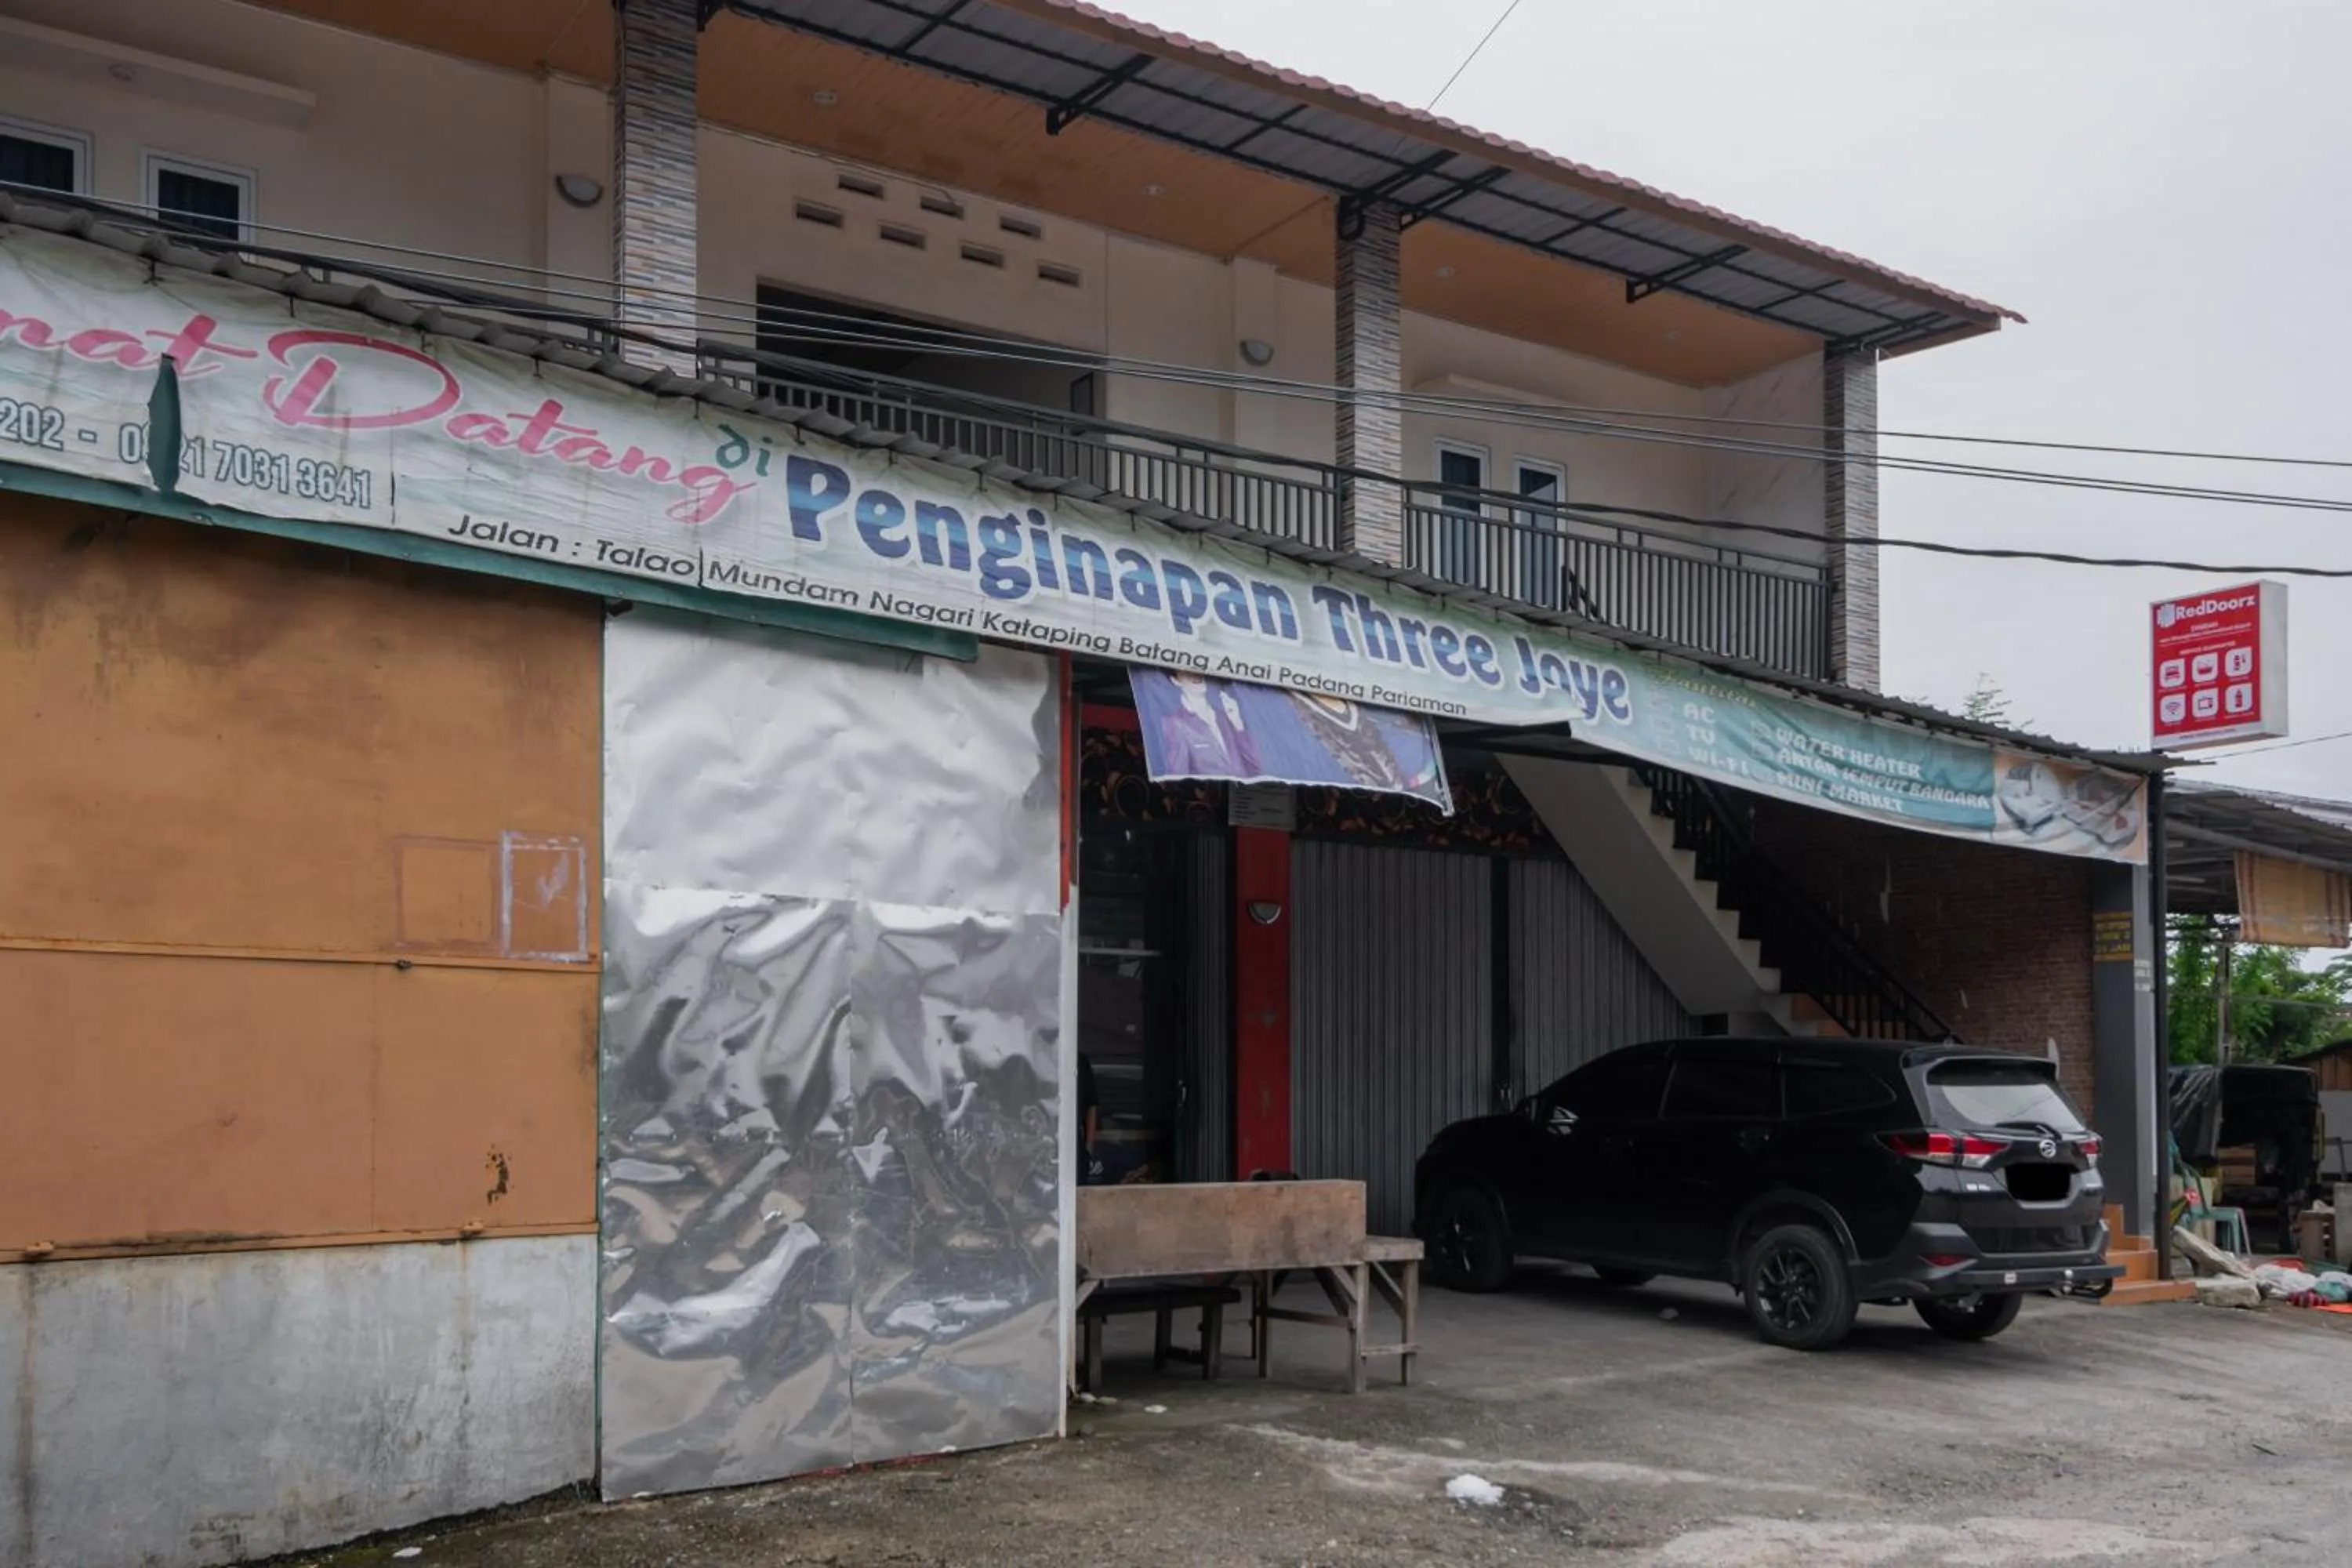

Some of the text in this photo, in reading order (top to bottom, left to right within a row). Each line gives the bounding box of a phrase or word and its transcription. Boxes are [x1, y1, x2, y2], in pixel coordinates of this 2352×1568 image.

[120, 423, 205, 478] 021
[213, 440, 289, 494] 7031
[296, 458, 371, 509] 3641
[263, 329, 757, 525] Datang
[716, 423, 774, 477] di
[786, 455, 1300, 640] Penginapan
[1312, 585, 1501, 685] Three
[448, 514, 559, 553] Jalan
[597, 539, 695, 575] Talao
[709, 561, 859, 606] Mundam
[869, 591, 975, 626] Nagari
[982, 612, 1111, 652] Kataping
[1120, 638, 1209, 669] Batang
[1217, 656, 1271, 680] Anai
[1279, 667, 1364, 698] Padang
[1372, 686, 1467, 715] Pariaman
[2176, 595, 2256, 619] RedDoorz
[1684, 702, 1716, 724] AC
[1777, 728, 1921, 778] WATER HEATER
[1778, 747, 1838, 775] ANTAR
[1910, 783, 1990, 809] BANDARA
[1777, 771, 1903, 812] MINI MARKET
